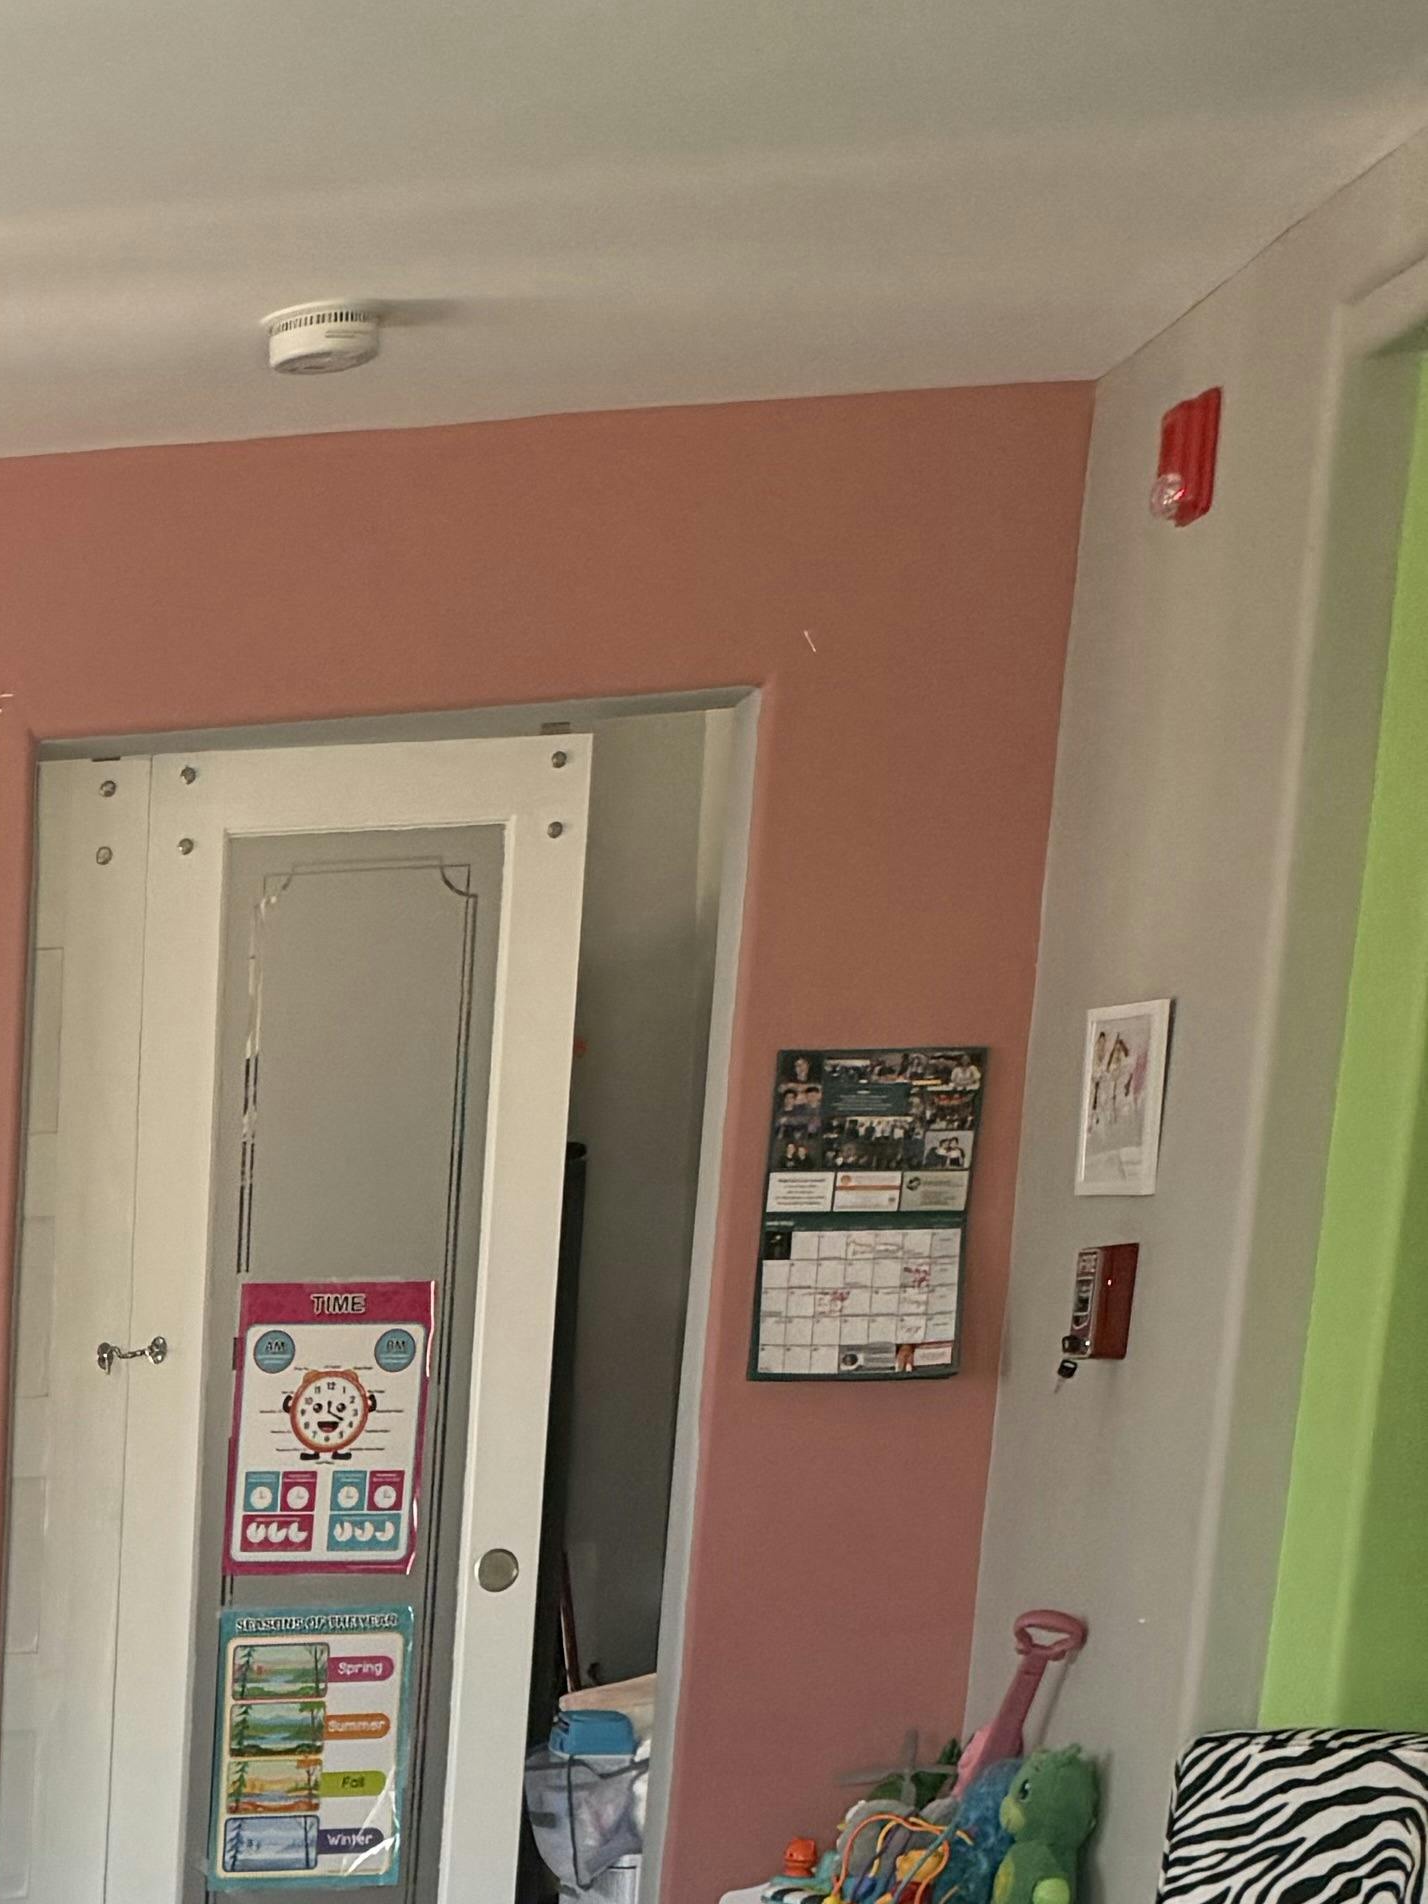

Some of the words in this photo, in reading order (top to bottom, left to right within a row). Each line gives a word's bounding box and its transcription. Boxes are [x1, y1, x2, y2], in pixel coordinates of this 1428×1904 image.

[311, 1293, 366, 1314] TIME
[337, 1661, 383, 1677] Spring
[327, 1719, 385, 1732] Summer
